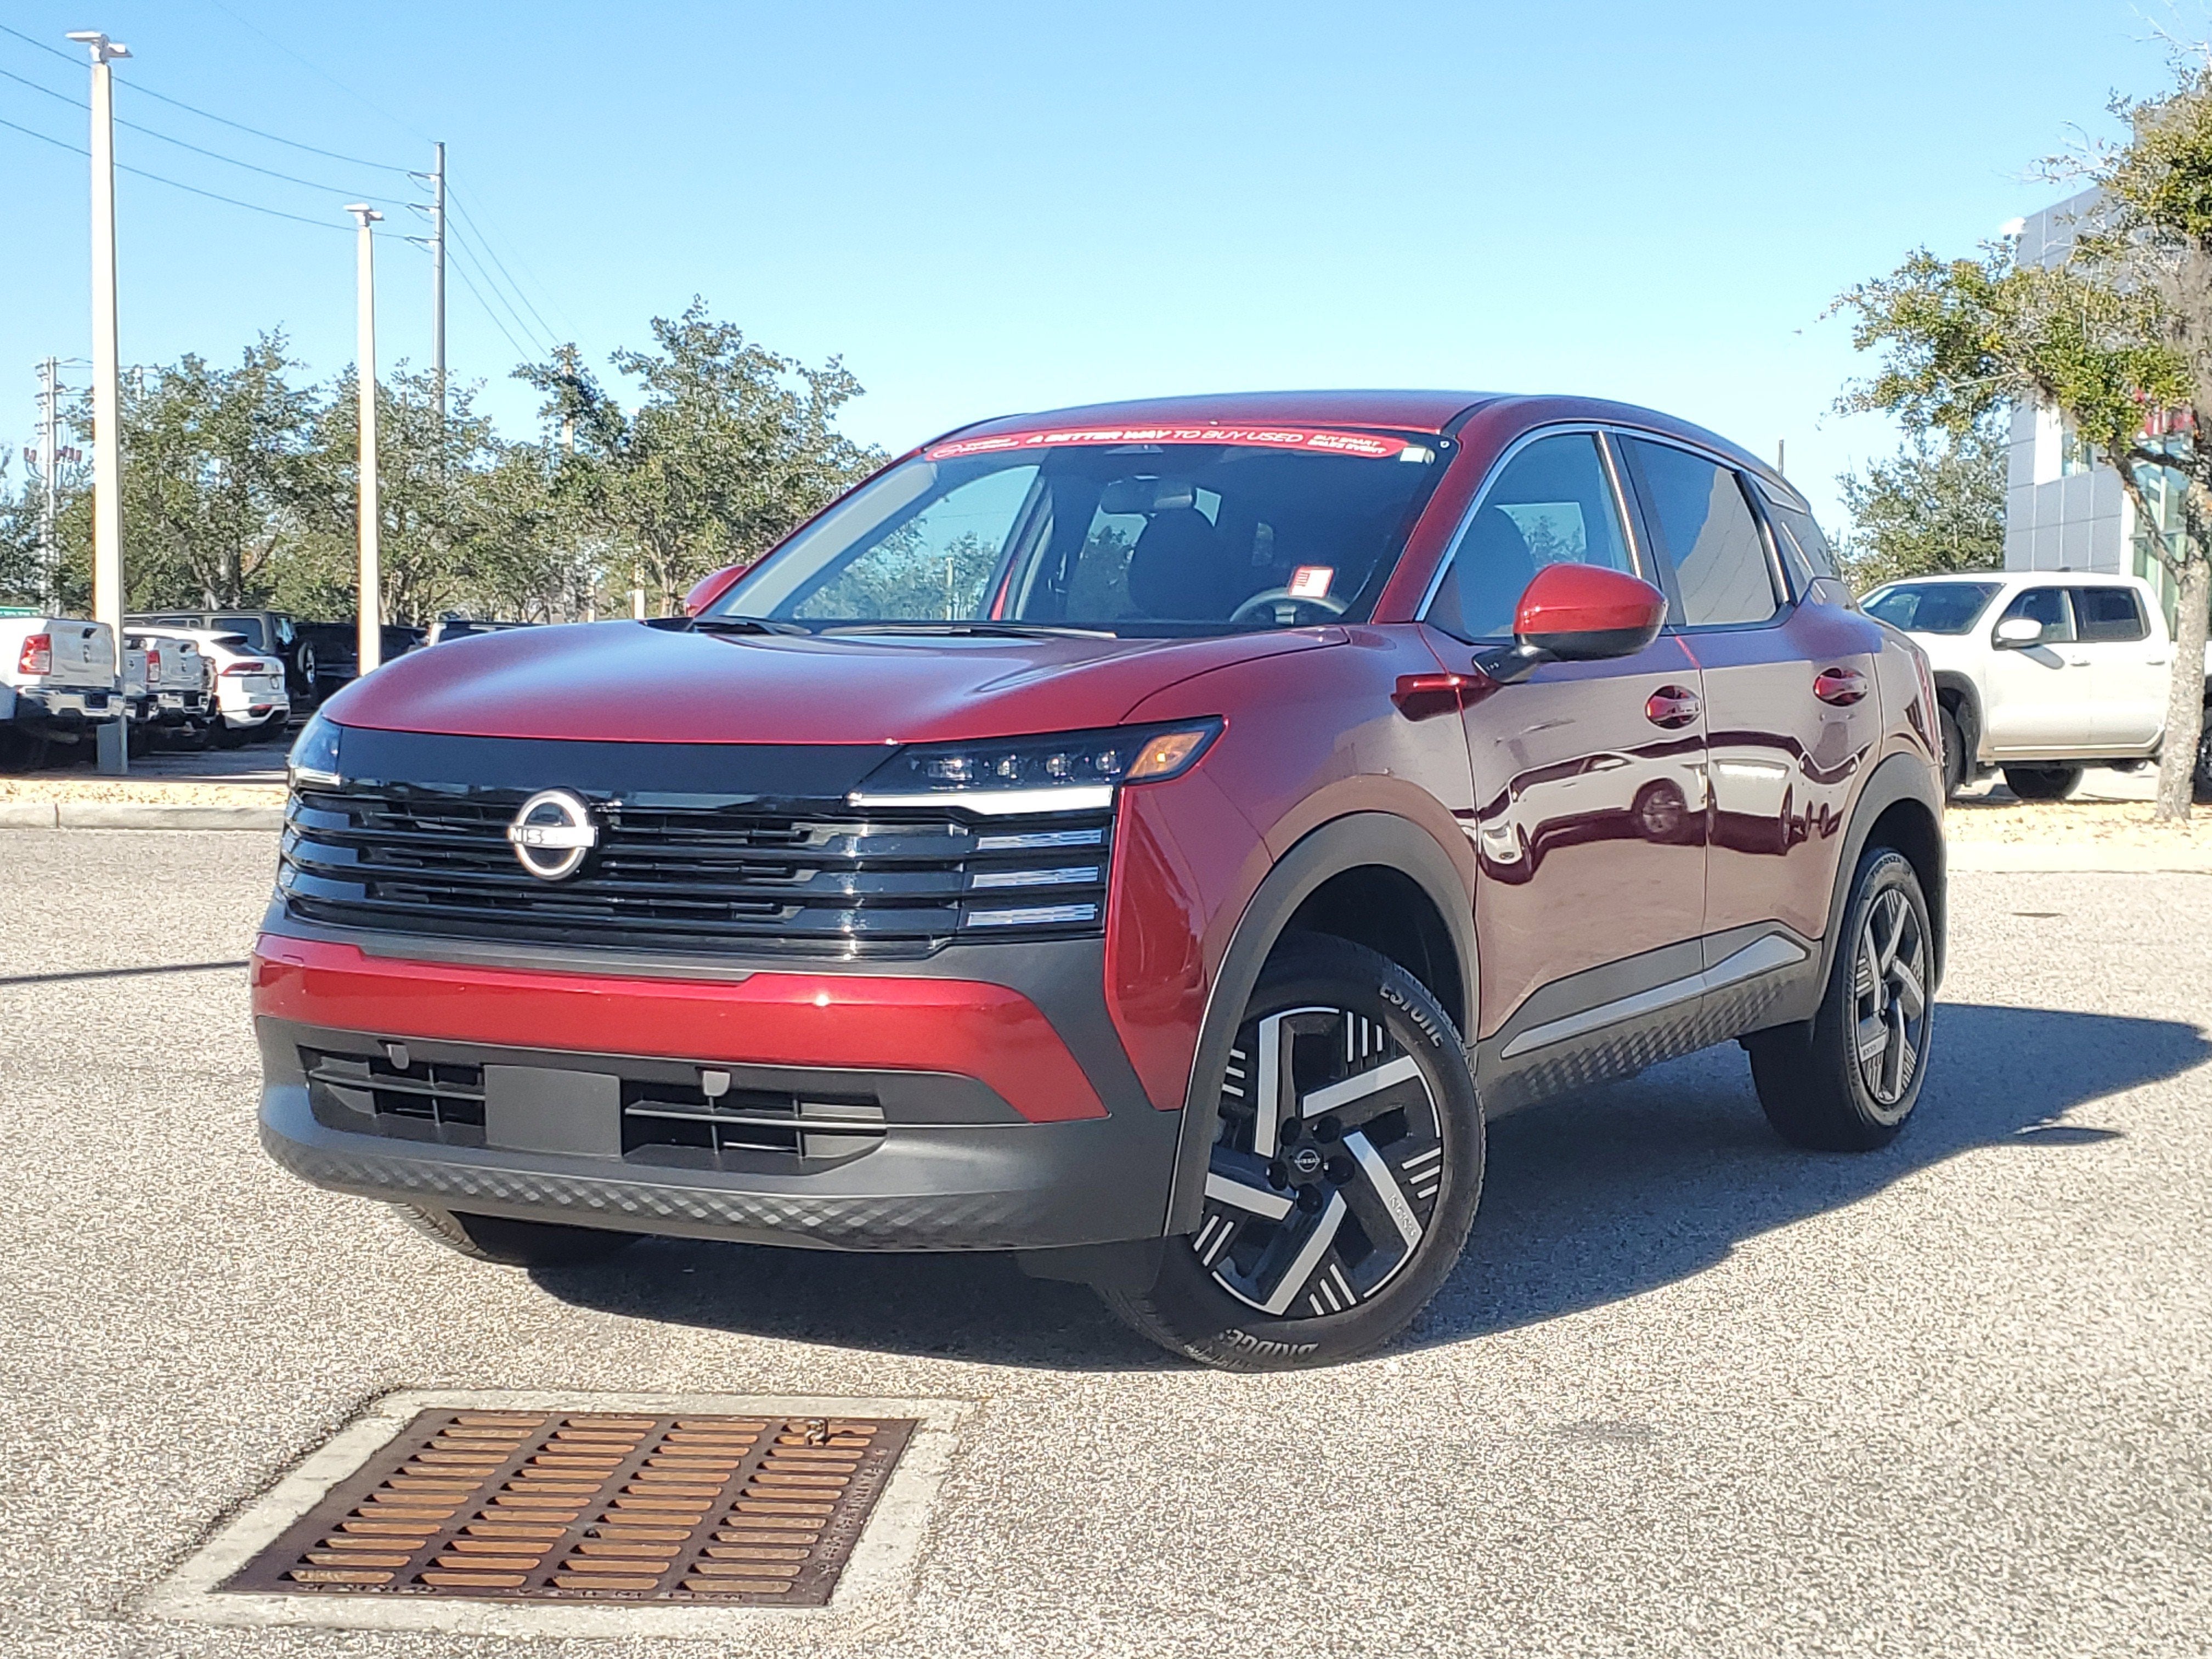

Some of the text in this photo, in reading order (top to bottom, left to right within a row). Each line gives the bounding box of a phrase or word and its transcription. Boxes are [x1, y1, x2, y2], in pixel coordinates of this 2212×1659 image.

[1025, 430, 1304, 444] A BETTER WAY TO BUY USED
